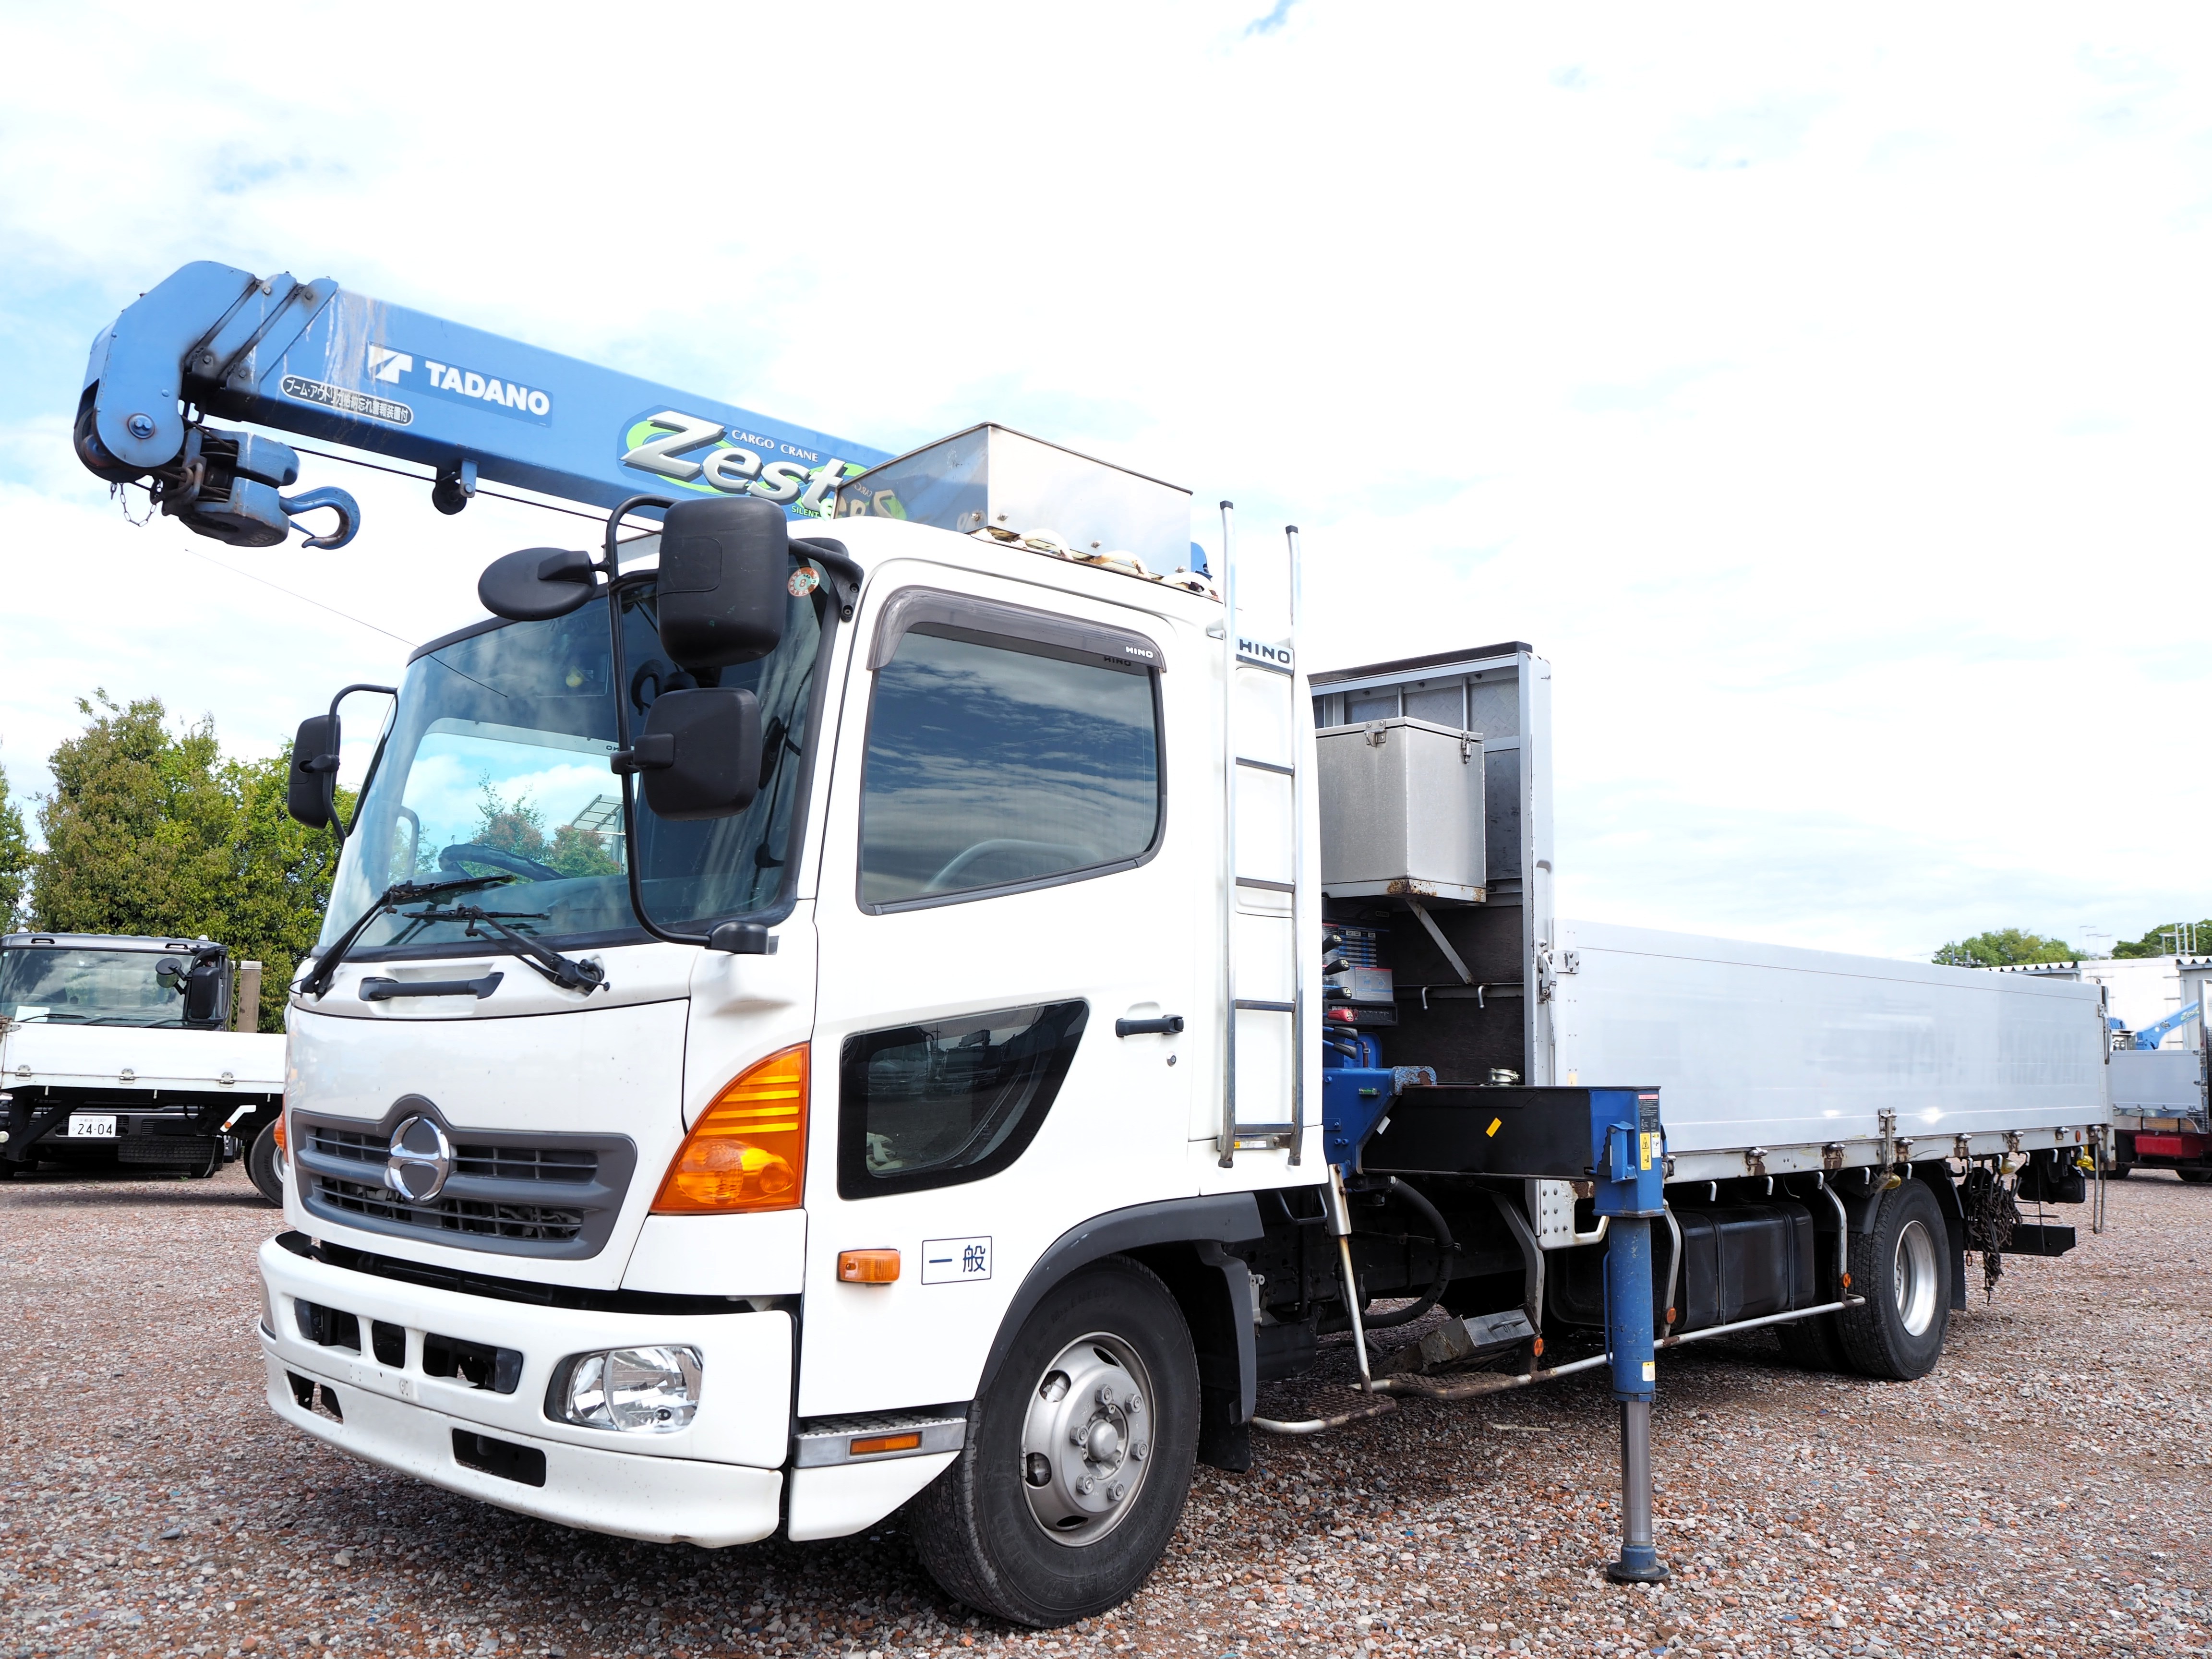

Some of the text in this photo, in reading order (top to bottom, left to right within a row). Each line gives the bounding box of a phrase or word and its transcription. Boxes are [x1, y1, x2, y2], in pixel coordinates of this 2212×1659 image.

[425, 360, 550, 416] TADANO
[731, 429, 818, 463] CARGO CRANE
[619, 410, 847, 512] Zest
[792, 505, 819, 519] SILENT
[1126, 645, 1154, 659] HINO
[1239, 638, 1290, 664] HINO
[77, 1123, 112, 1135] 24-04
[928, 1244, 986, 1273] 一般
